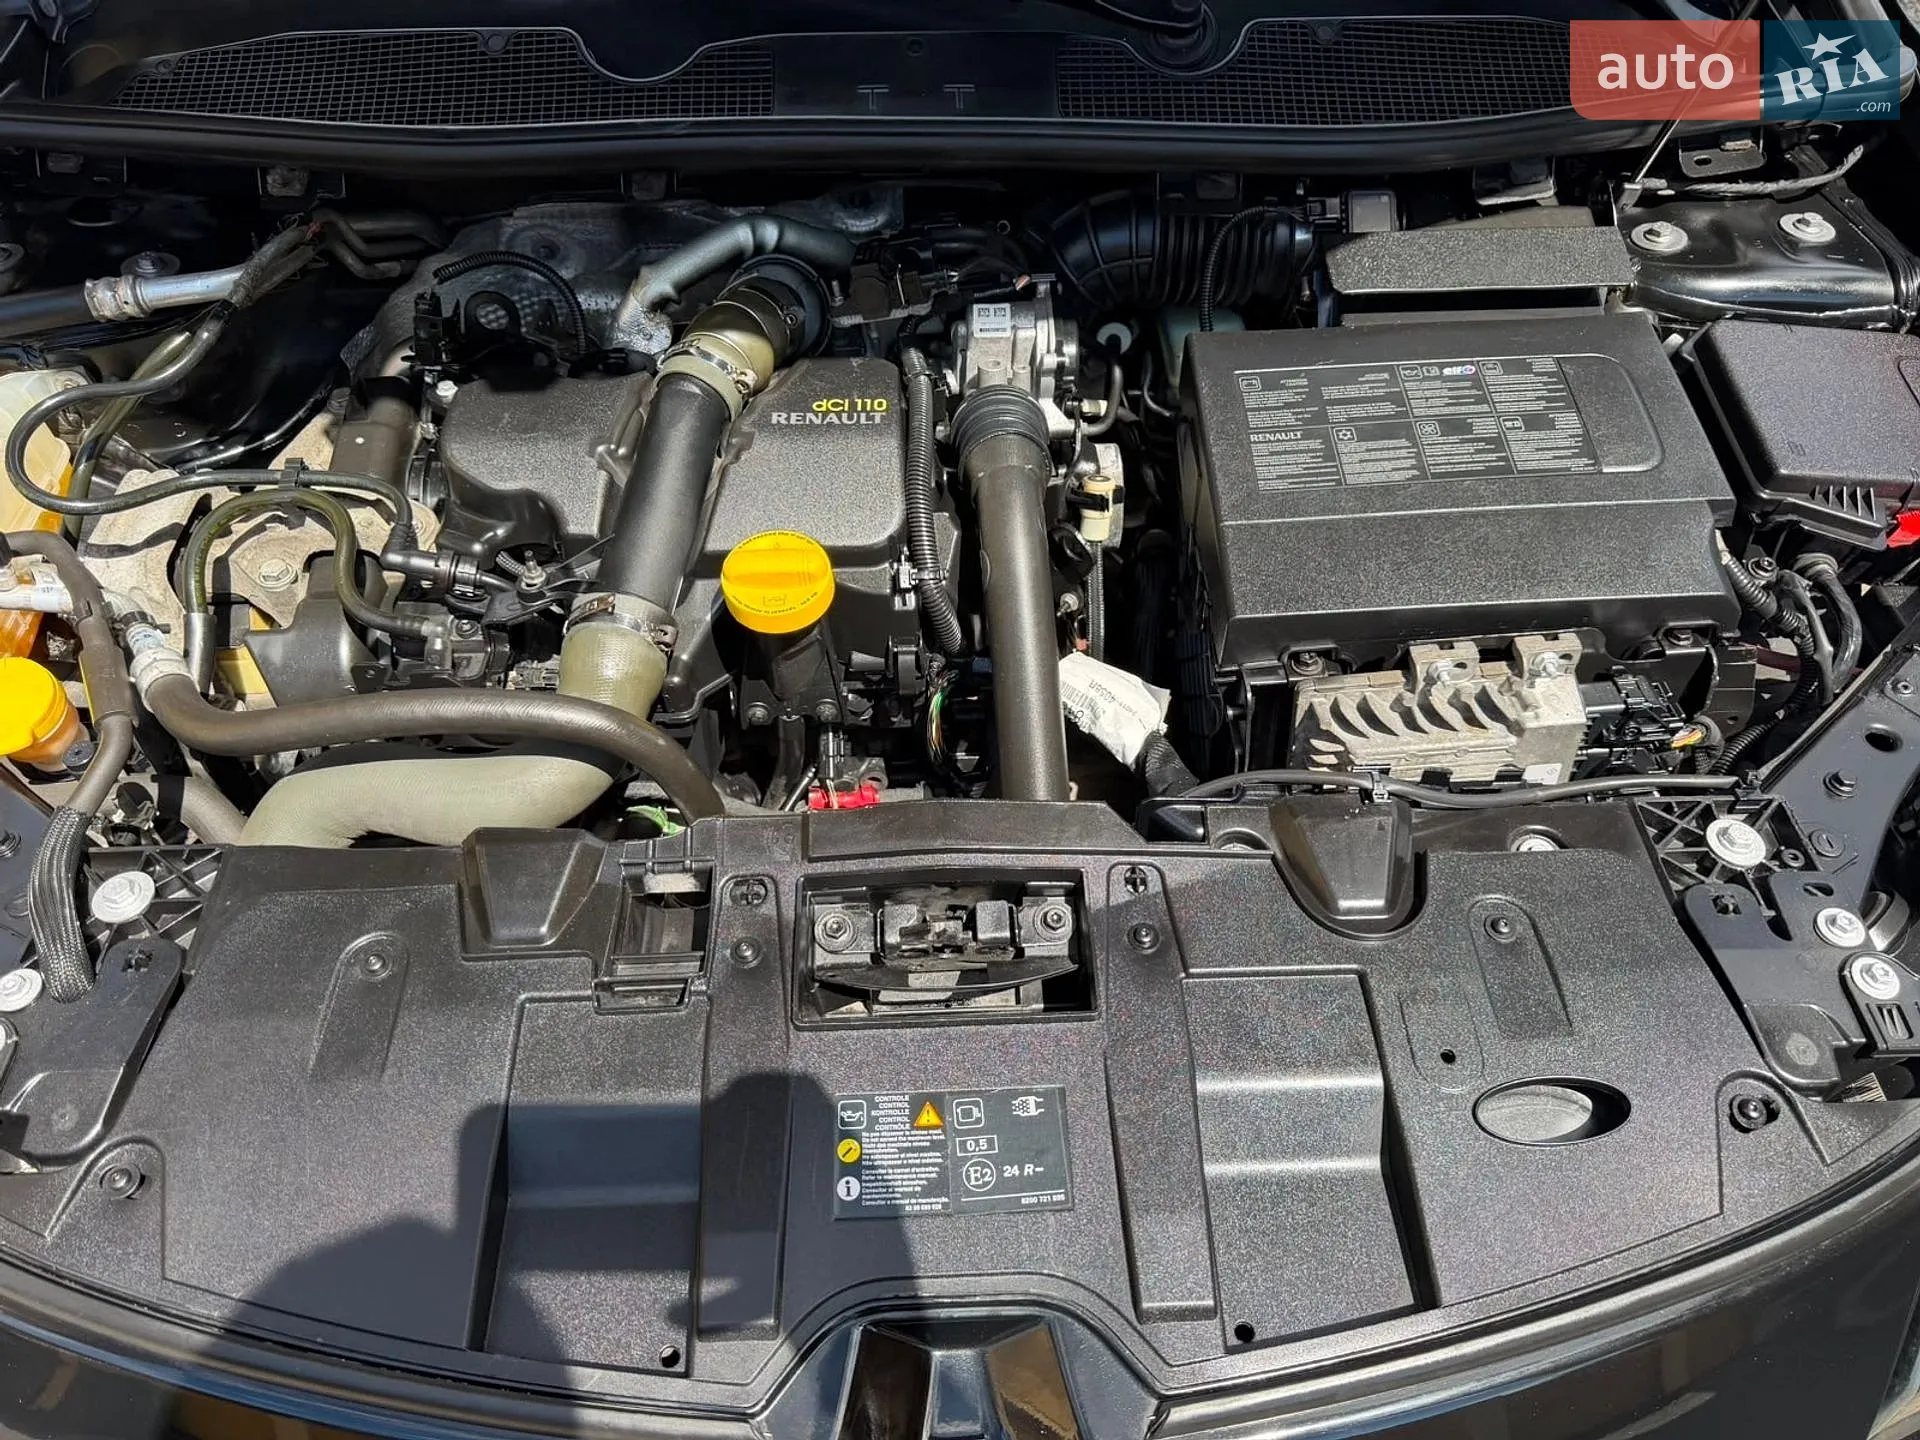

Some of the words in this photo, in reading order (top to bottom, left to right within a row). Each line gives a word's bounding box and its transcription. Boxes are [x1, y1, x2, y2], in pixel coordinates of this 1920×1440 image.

[855, 398, 887, 411] 110
[771, 412, 887, 425] RENAULT
[1250, 431, 1303, 443] RENAULT
[966, 1139, 988, 1152] 0,5
[968, 1166, 993, 1185] E2
[1003, 1164, 1020, 1177] 24
